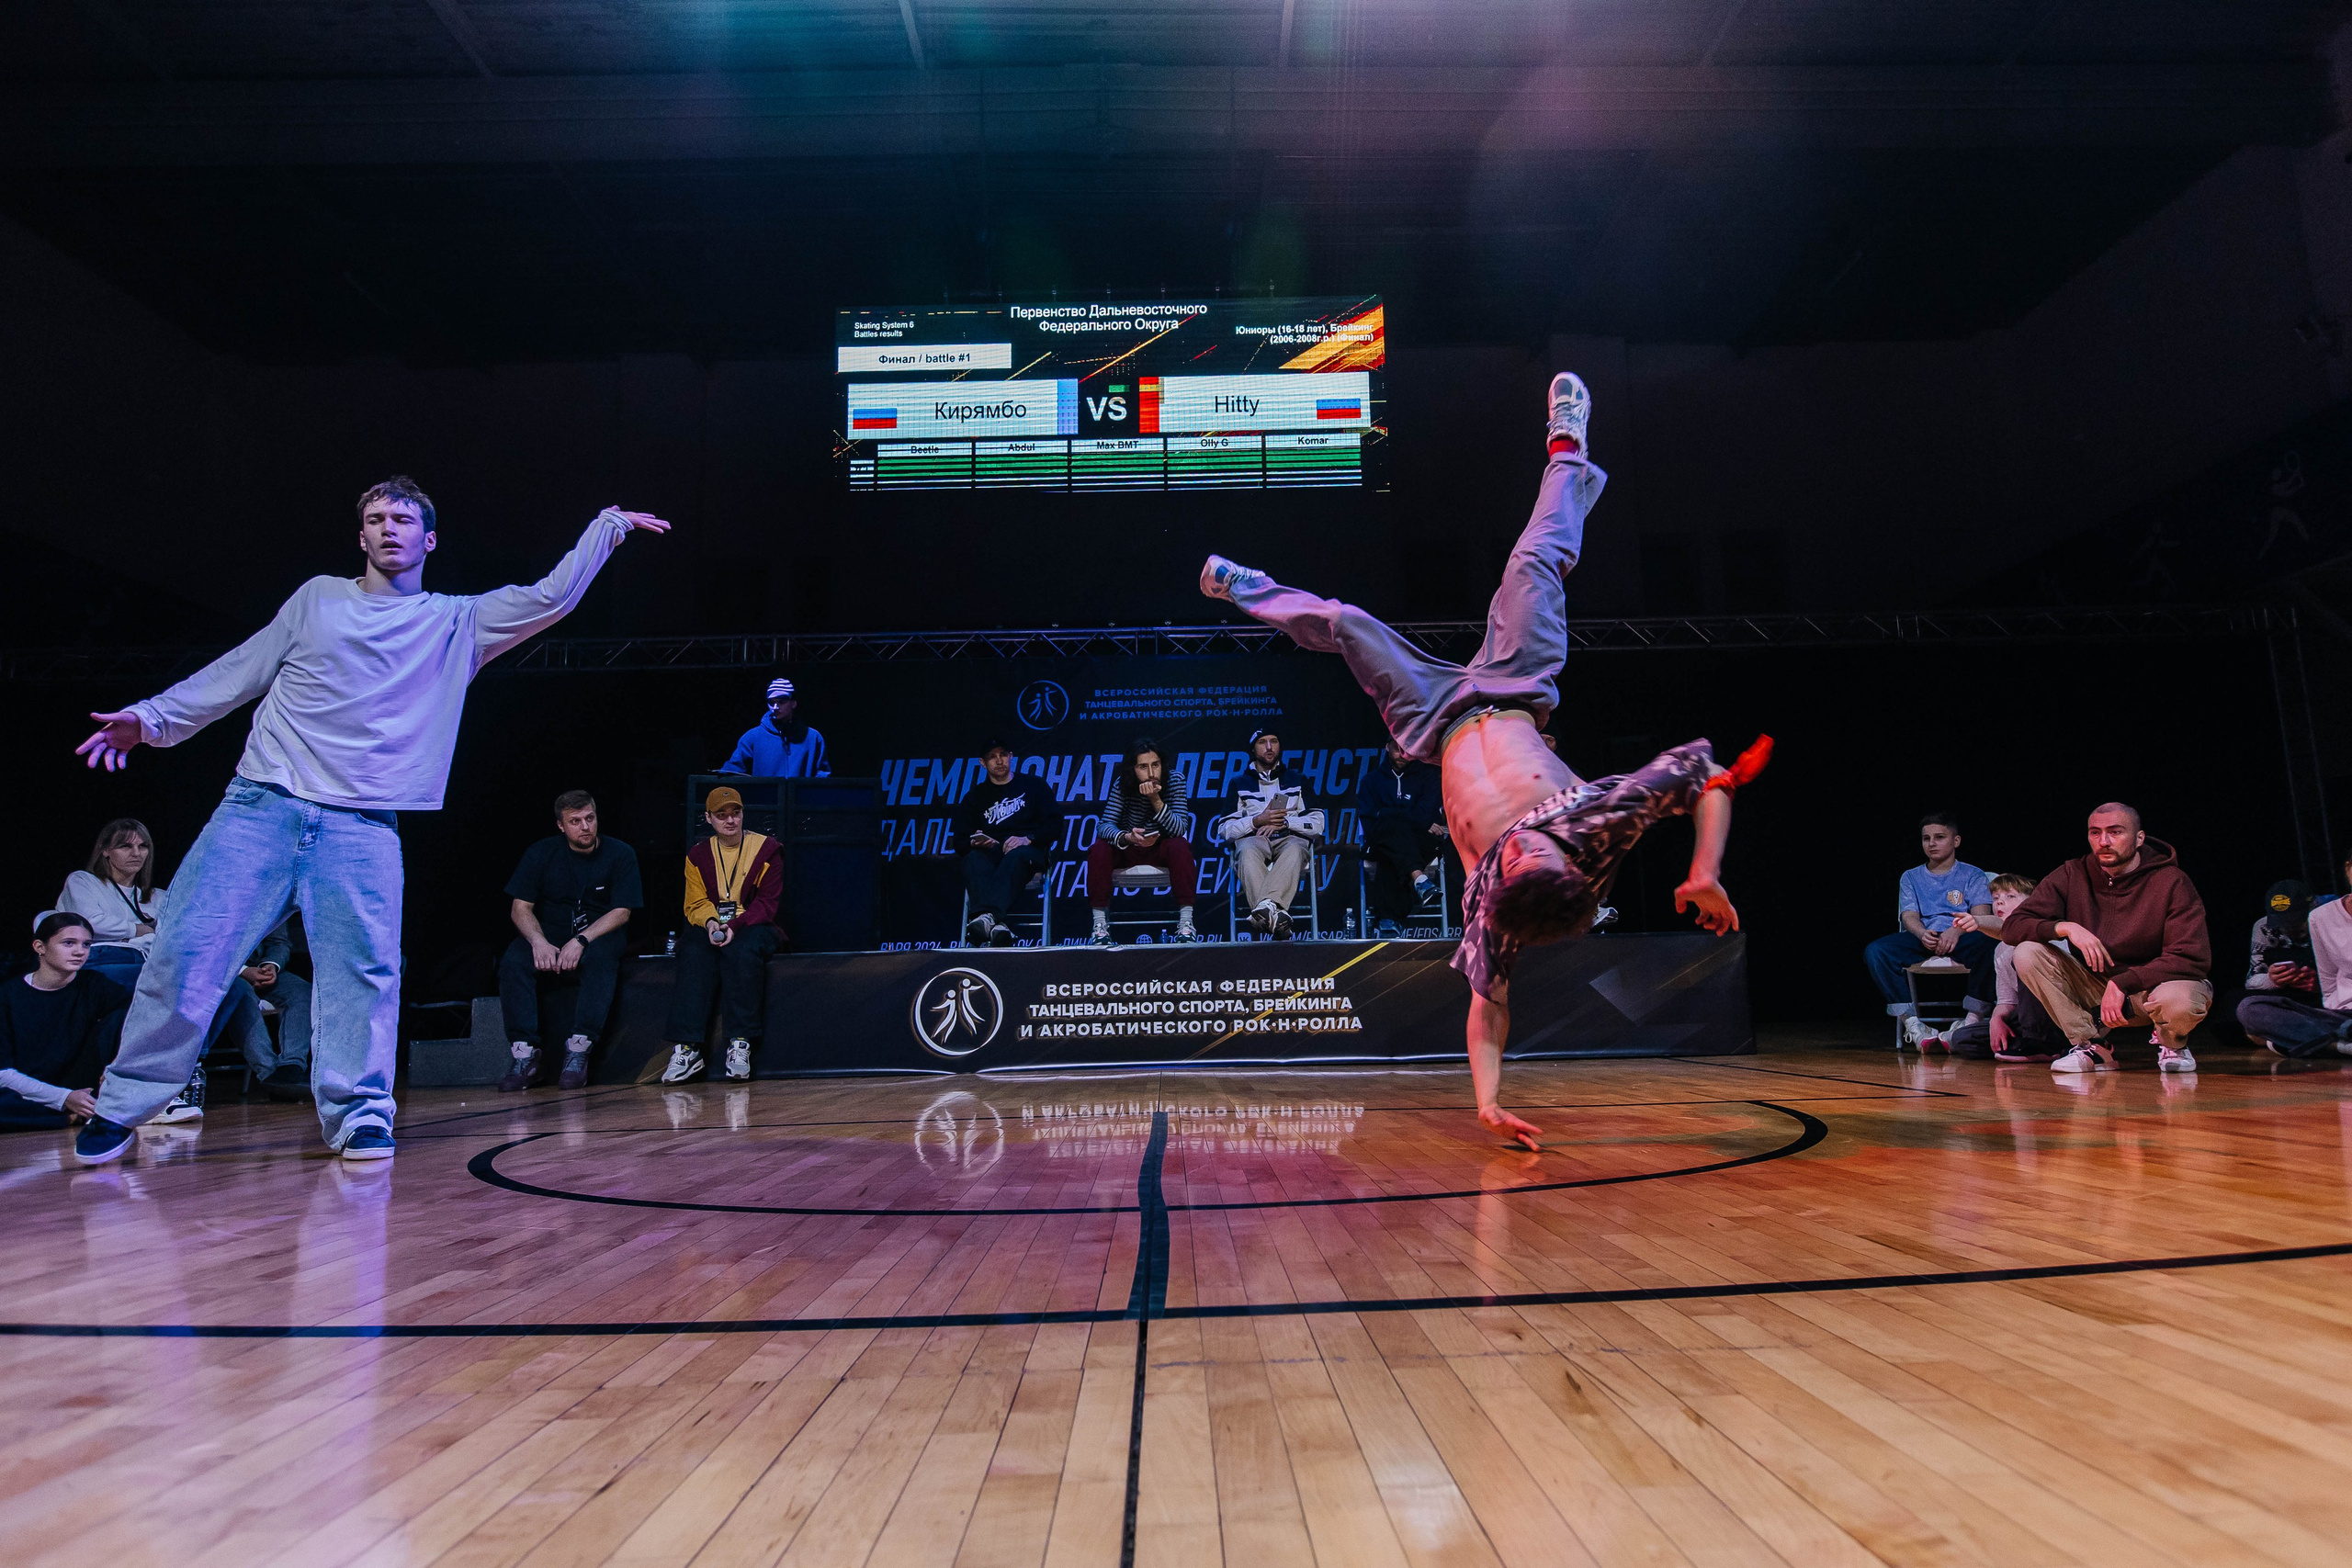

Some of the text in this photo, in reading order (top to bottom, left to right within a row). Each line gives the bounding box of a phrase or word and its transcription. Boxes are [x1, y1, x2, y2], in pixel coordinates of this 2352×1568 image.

[1011, 303, 1207, 320] Первенство Дальневосточного
[882, 321, 908, 330] System
[1039, 318, 1179, 333] Федерального Округа
[1236, 325, 1276, 335] Юниоры
[1278, 324, 1305, 334] (16-18
[1337, 333, 1374, 343] (Финал)
[878, 353, 971, 364] Финал / battle #1
[1086, 396, 1127, 421] VS
[1215, 395, 1260, 416] Hitty
[934, 401, 1027, 423] Кирямбо
[1097, 440, 1139, 449] Max BMT
[1200, 438, 1228, 448] Olly G
[1297, 436, 1329, 446] Komar
[910, 446, 939, 455] Beetle
[1008, 443, 1035, 452] Abdul
[1094, 686, 1267, 696] ВСЕРОССИЙСКАЯ ФЕДЕРАЦИЯ
[1085, 696, 1277, 709] ТАНЦЕВАЛЬНОГО СПОРТА, БРЕЙКИНГА
[1091, 710, 1202, 720] АКРОБАТИЧЕСКОГО
[1046, 977, 1335, 997] ВСЕРОССИЙСКАЯ ФЕДЕРАЦИЯ
[1030, 997, 1352, 1017] ТАНЦЕВАЛЬНОГО СПОРТА, БРЕЙКИНГА
[1021, 1026, 1033, 1037] И
[1040, 1020, 1226, 1036] АКРОБАТИЧЕСКОГО
